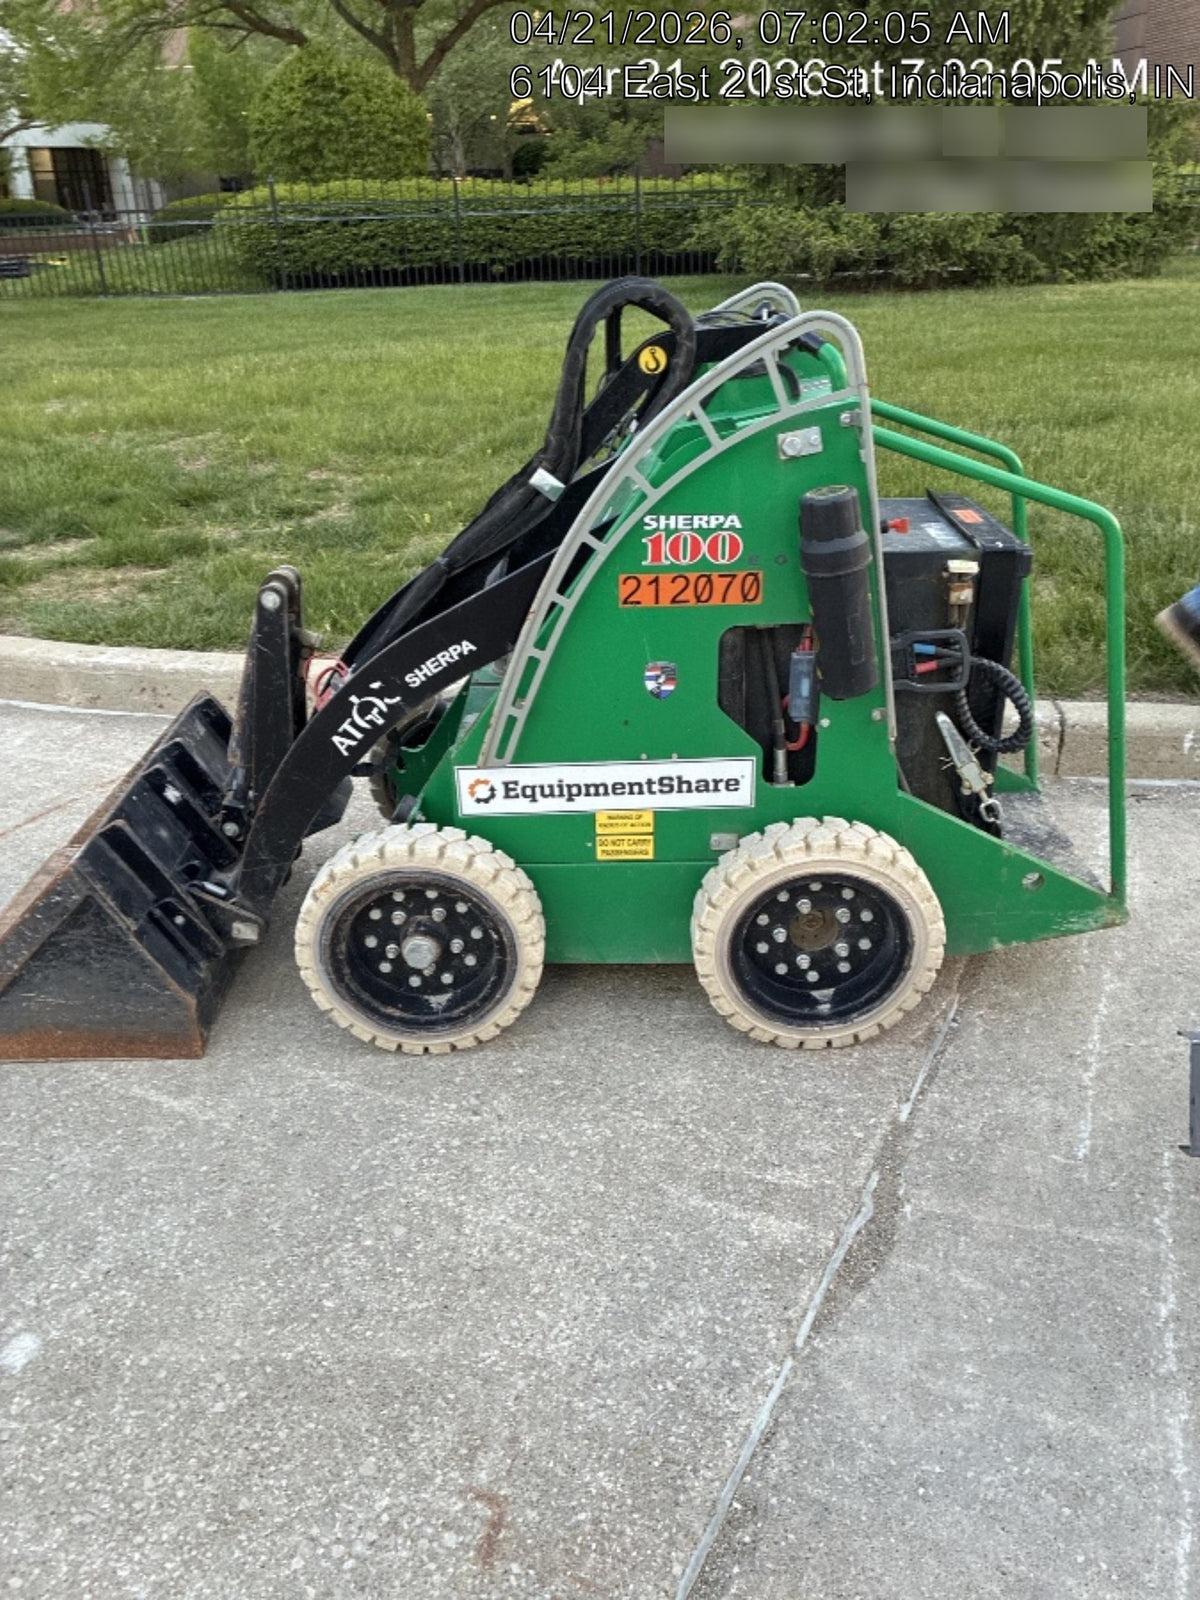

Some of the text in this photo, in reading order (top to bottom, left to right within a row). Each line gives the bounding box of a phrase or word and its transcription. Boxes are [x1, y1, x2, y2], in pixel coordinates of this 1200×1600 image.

[643, 514, 743, 530] SHERPA
[641, 531, 744, 565] 100
[621, 571, 761, 605] 212070
[404, 639, 478, 688] SHERPA
[502, 774, 742, 803] EquipmentShare
